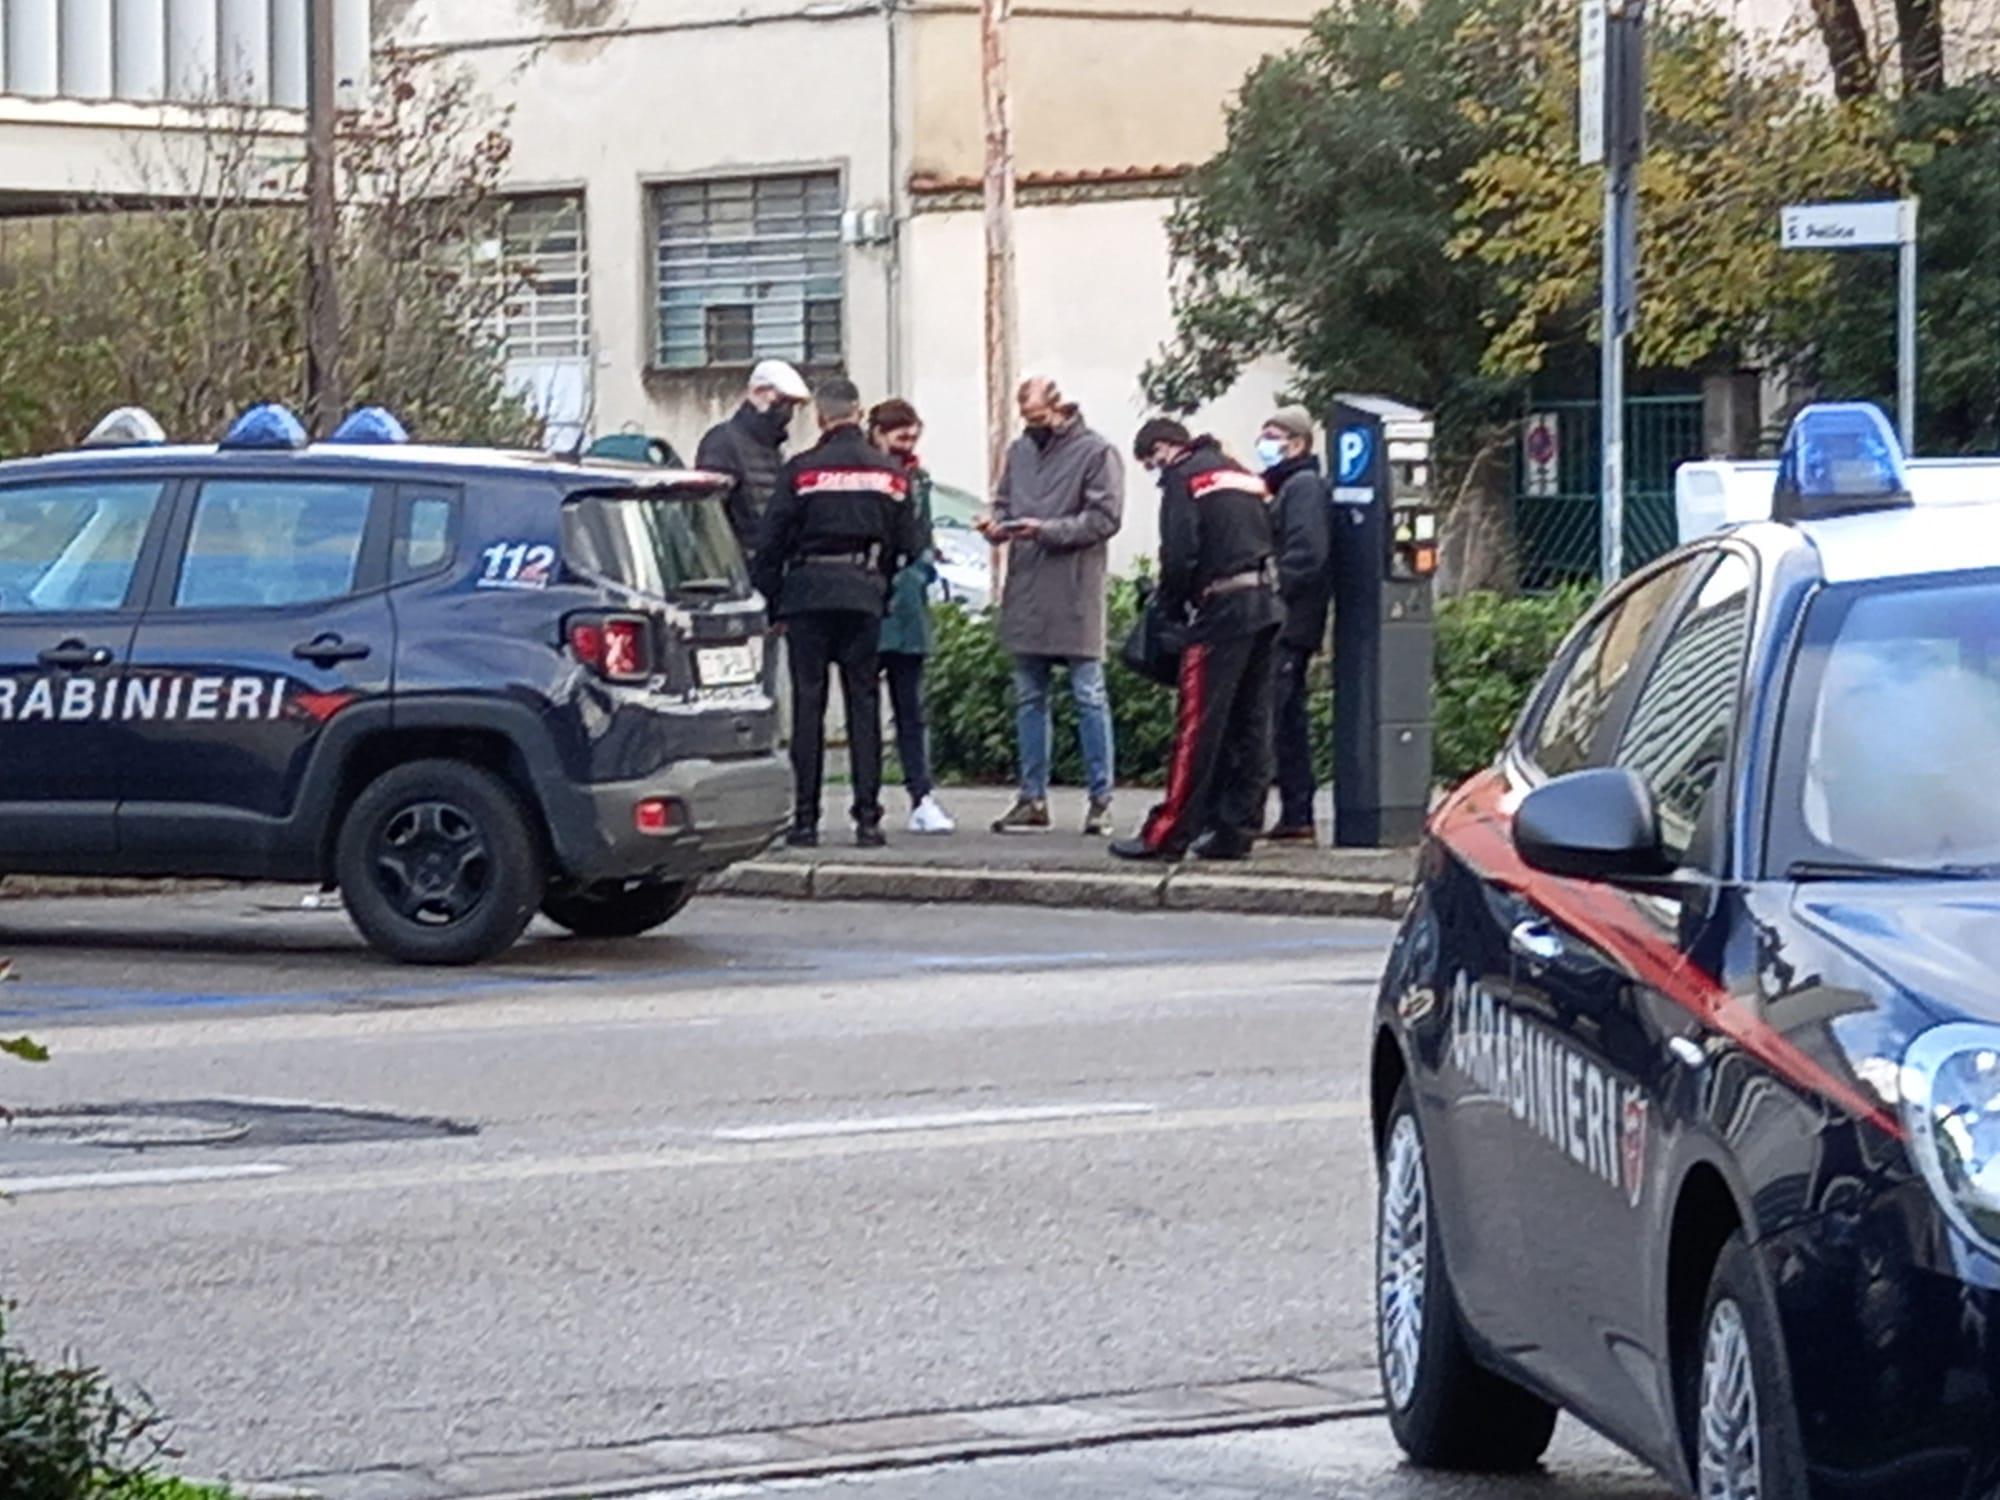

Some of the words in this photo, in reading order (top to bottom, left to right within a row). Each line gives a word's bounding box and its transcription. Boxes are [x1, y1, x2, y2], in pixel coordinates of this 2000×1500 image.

[1340, 432, 1364, 475] P
[482, 543, 555, 580] 112
[1453, 967, 1620, 1188] CARABINIERI
